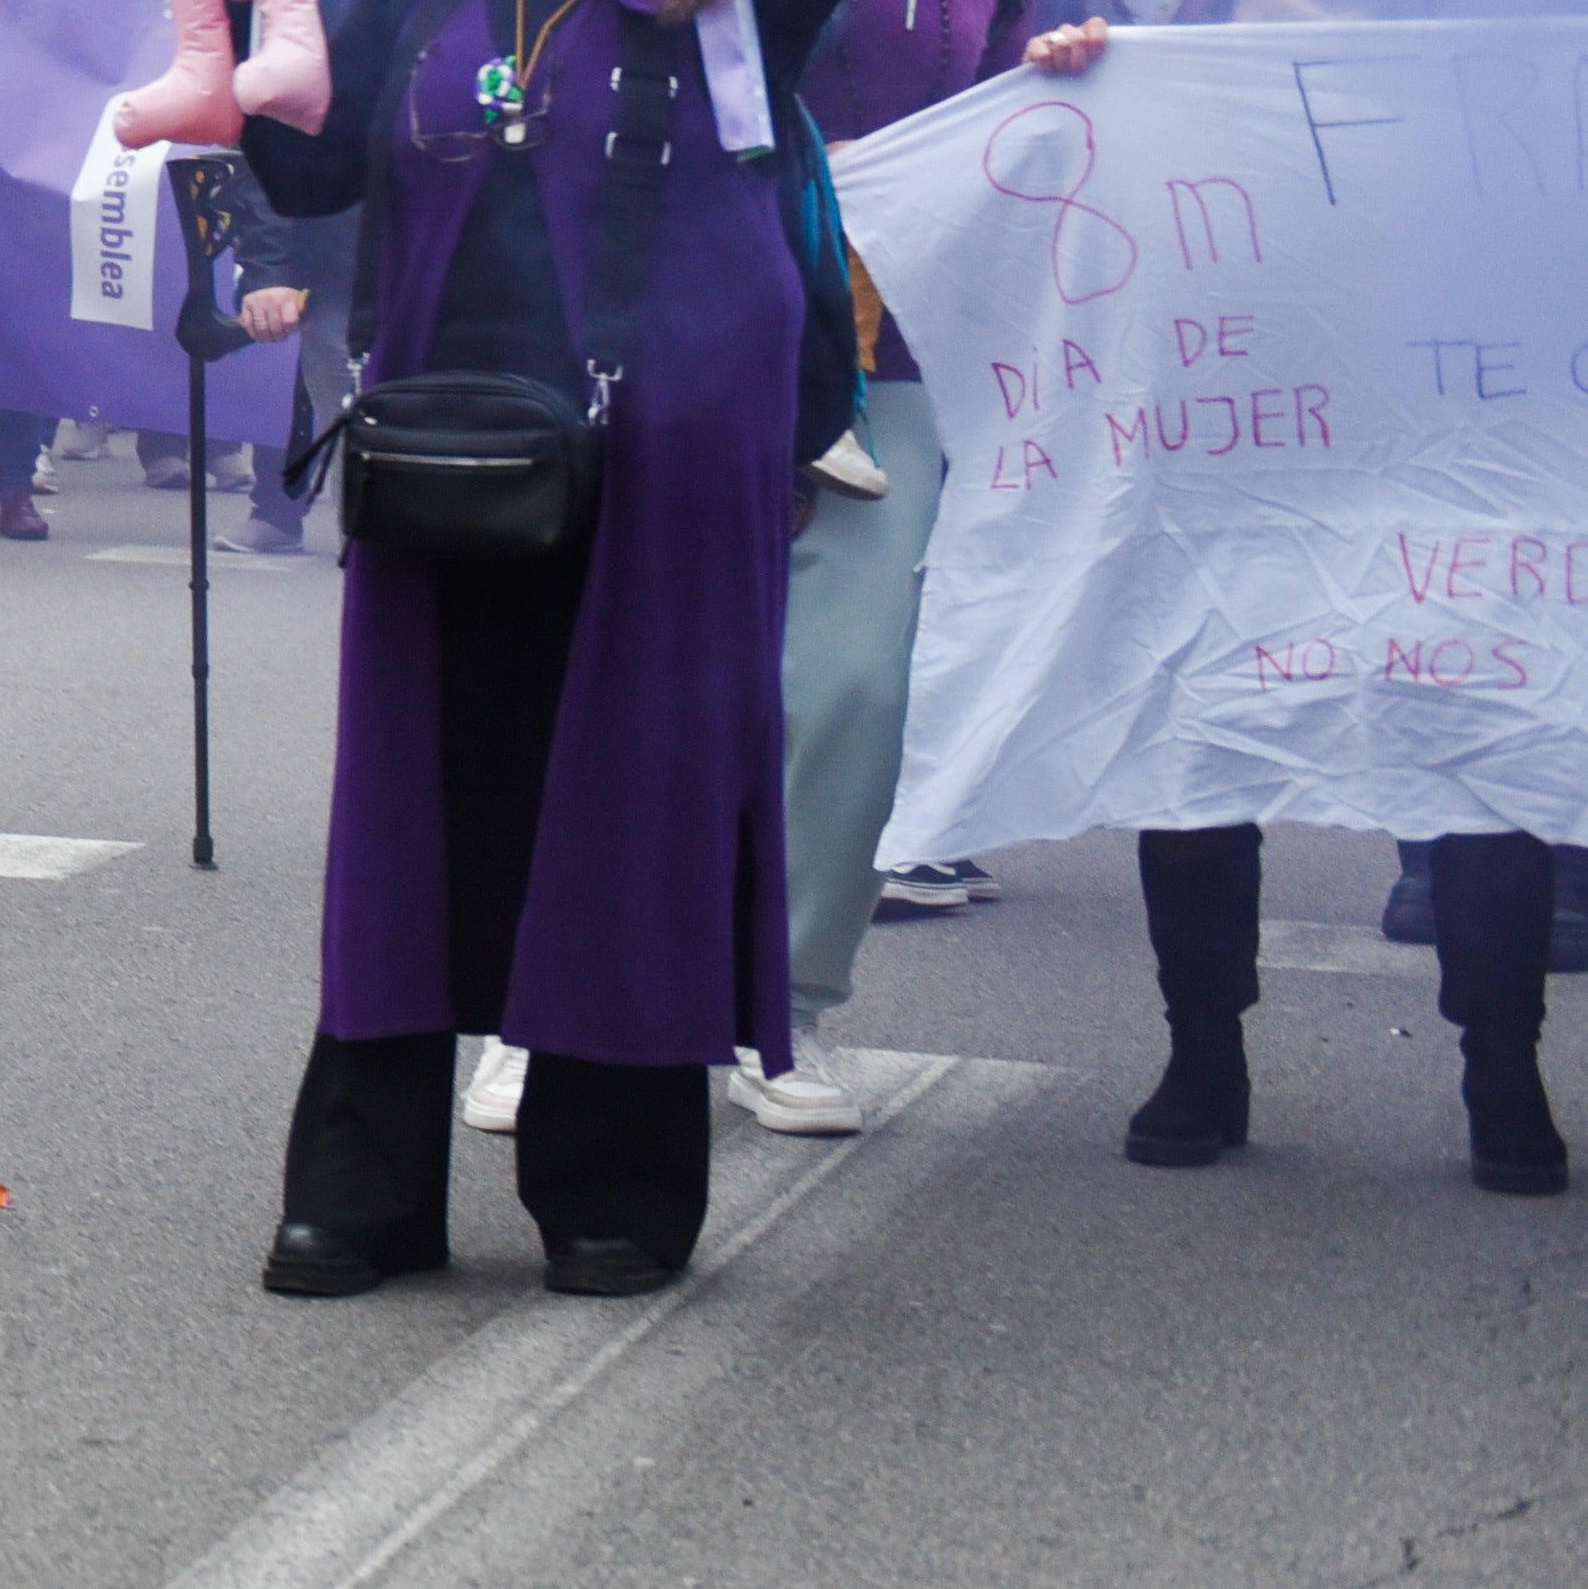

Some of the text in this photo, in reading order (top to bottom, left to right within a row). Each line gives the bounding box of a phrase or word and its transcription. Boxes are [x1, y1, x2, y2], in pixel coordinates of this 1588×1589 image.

[100, 148, 138, 300] semblea
[1174, 315, 1255, 368] DE
[1405, 340, 1528, 400] TE
[990, 384, 1331, 491] LA MUJER
[1255, 637, 1529, 692] NO NOS
